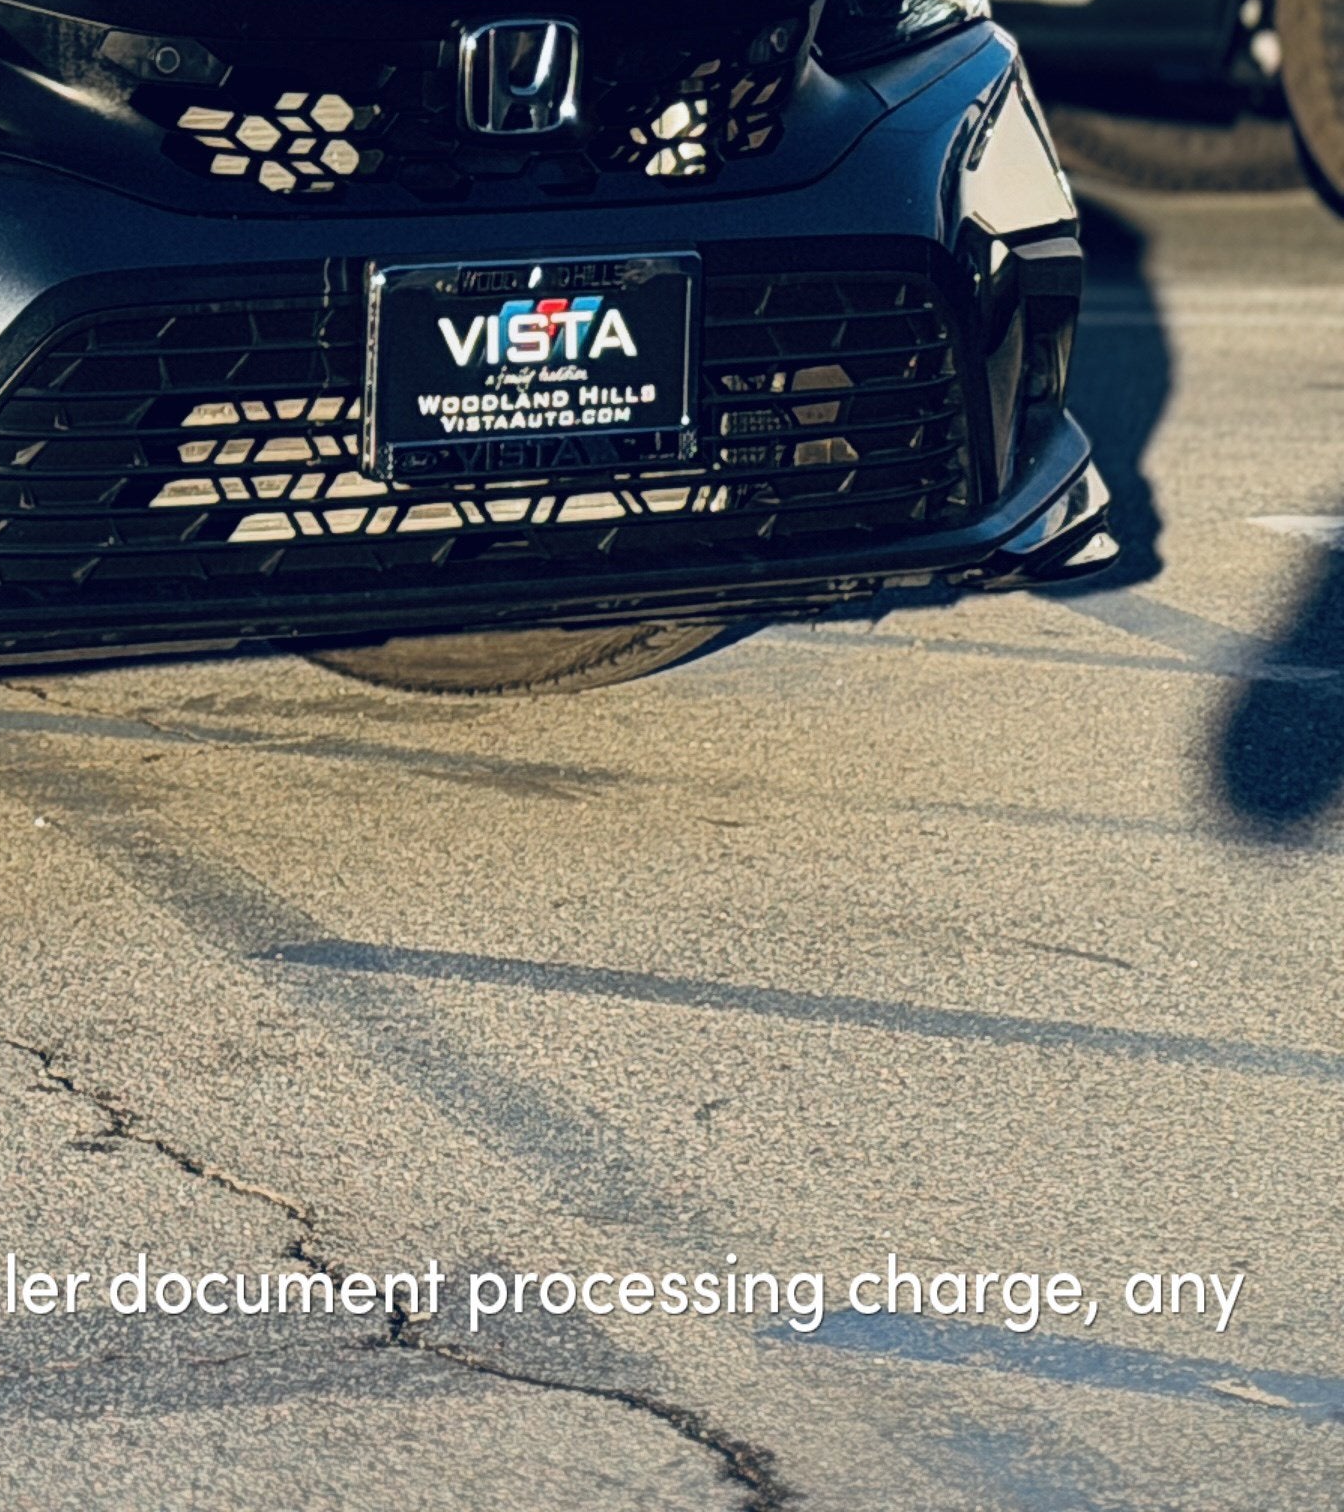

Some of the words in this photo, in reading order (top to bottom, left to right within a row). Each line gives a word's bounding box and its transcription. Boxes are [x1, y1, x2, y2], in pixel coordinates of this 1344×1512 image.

[437, 308, 638, 367] VISTA
[418, 389, 569, 416] WOODLAND
[578, 384, 656, 406] HILLS
